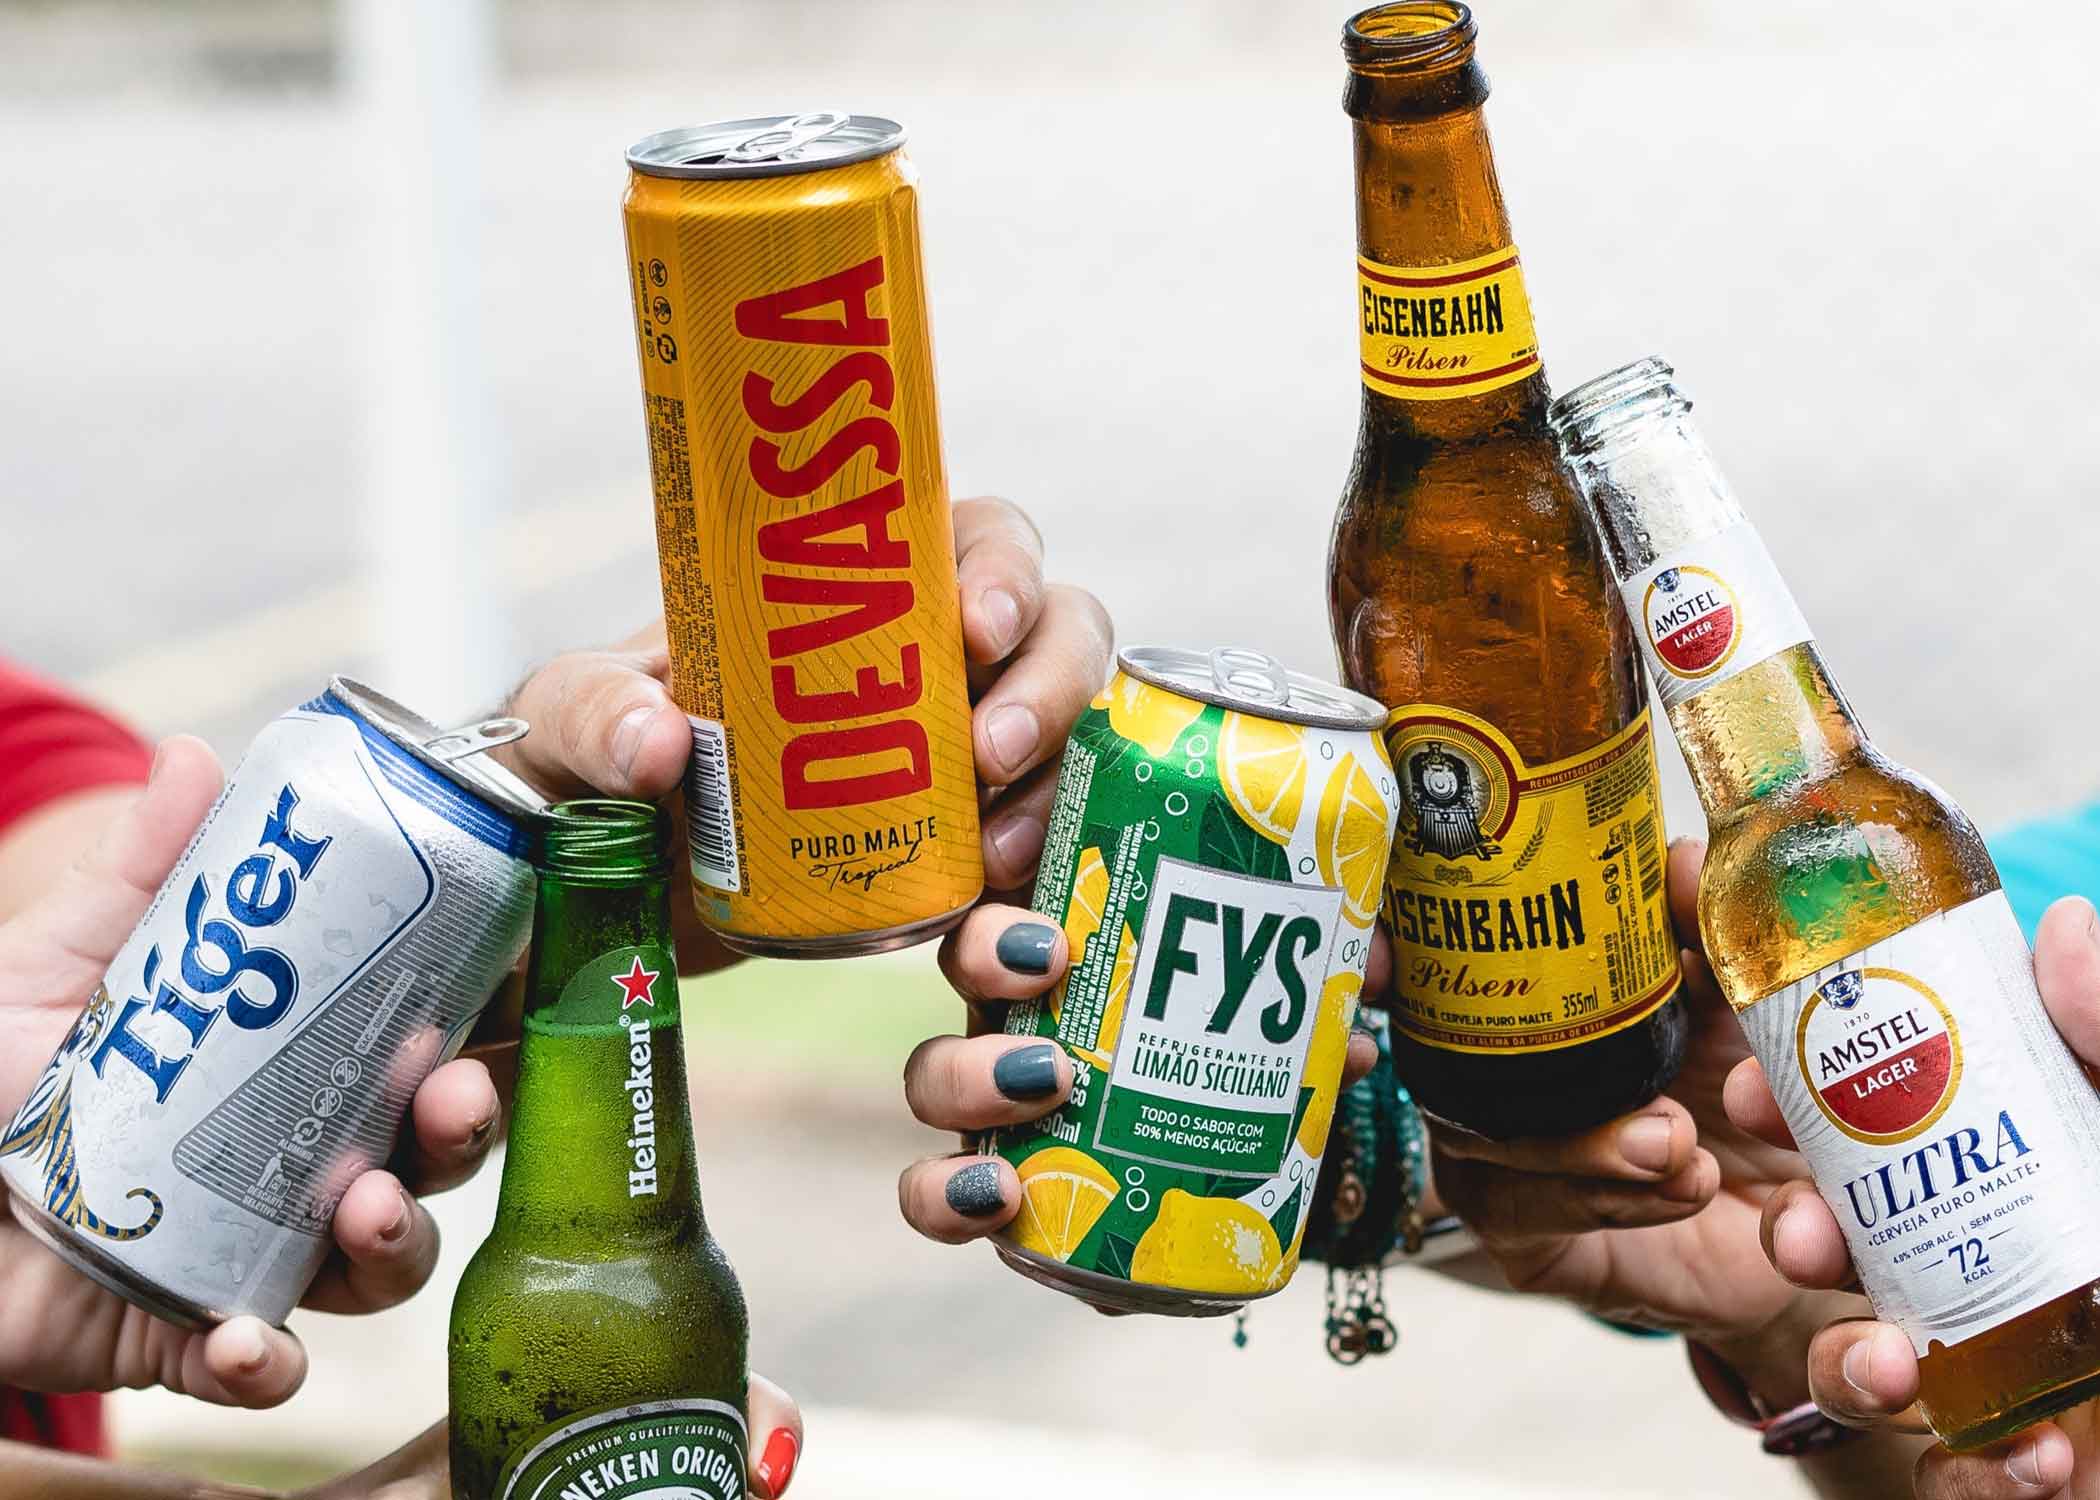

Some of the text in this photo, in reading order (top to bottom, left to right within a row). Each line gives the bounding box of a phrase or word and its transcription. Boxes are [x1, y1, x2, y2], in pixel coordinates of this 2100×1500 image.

[1362, 283, 1504, 337] EISENBAHN
[1386, 344, 1472, 371] Pilsen
[735, 255, 932, 811] DEVASSA
[1654, 590, 1720, 637] AMSTEL
[1674, 621, 1714, 649] LAGER
[712, 737, 737, 887] 7 898904 771606
[791, 816, 938, 859] PURO MALTE
[808, 841, 921, 893] Tropical
[1125, 859, 1136, 873] AO
[1107, 875, 1122, 903] VALOR
[1115, 872, 1134, 911] IDÊNTICO
[1098, 917, 1112, 944] BAIXO
[1104, 903, 1116, 918] EM
[90, 782, 332, 1104] Tiger
[1105, 910, 1125, 954] SINTÉTICO
[1088, 943, 1107, 985] ALIMENTO
[1091, 954, 1115, 1016] AROMATIZANTE
[1143, 890, 1322, 1045] FYS
[1410, 956, 1541, 998] Pilsen
[1056, 968, 1081, 1040] NOVA RECEITA
[1065, 935, 1099, 1043] REFRIGERANTE DE LIMÃO
[1085, 986, 1097, 1000] UM
[1440, 985, 1599, 1027] CERVEJA PURO MALTE 355ml
[1074, 1024, 1088, 1046] ESTE
[1078, 1006, 1092, 1025] NÃO
[1083, 1015, 1101, 1050] CONTÉM
[1843, 1012, 1871, 1030] 1870
[1138, 1032, 1293, 1068] REFRIGERANTE DE
[1819, 1009, 1928, 1081] AMSTEL
[1132, 1047, 1290, 1098] LIMÃO SICILIANO
[1853, 1057, 1918, 1099] LAGER
[624, 1019, 657, 1198] Heineken
[1140, 1105, 1264, 1138] TODO O SABOR COM
[1133, 1122, 1161, 1140] 50%
[1164, 1130, 1210, 1149] MENOS
[1843, 1110, 2032, 1229] ULTRA
[1931, 1190, 1975, 1219] PURO
[1911, 1239, 1935, 1256] TEOR
[1936, 1230, 1958, 1246] ALC.
[1970, 1213, 1992, 1229] SEM
[1948, 1237, 1990, 1274] 72
[1963, 1264, 1995, 1285] KCAL
[566, 1435, 623, 1466] PREMIUM
[629, 1425, 680, 1442] QUALITY
[685, 1424, 714, 1436] LAGER
[672, 1446, 742, 1500] ORIGIN
